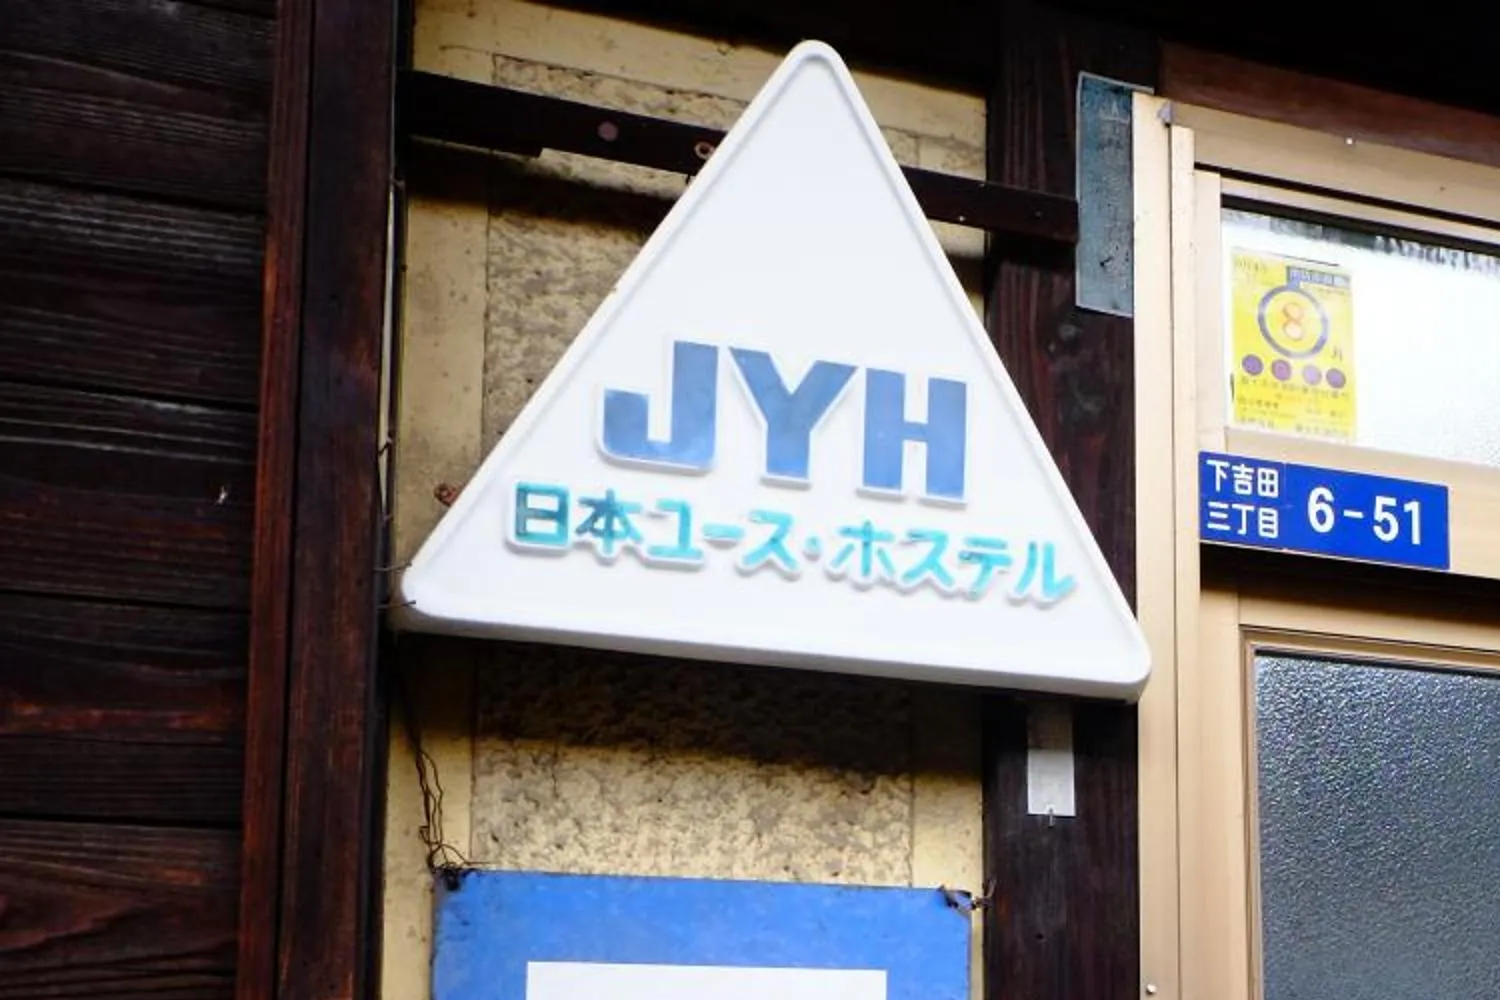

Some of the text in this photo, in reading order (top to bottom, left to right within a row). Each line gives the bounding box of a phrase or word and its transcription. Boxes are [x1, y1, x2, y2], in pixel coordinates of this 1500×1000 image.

[602, 340, 968, 500] JYH
[1206, 459, 1280, 498] 下吉田
[513, 482, 1075, 603] 日本ユース・ホステル
[1206, 501, 1280, 539] 三丁目
[1307, 486, 1422, 545] 6-51
